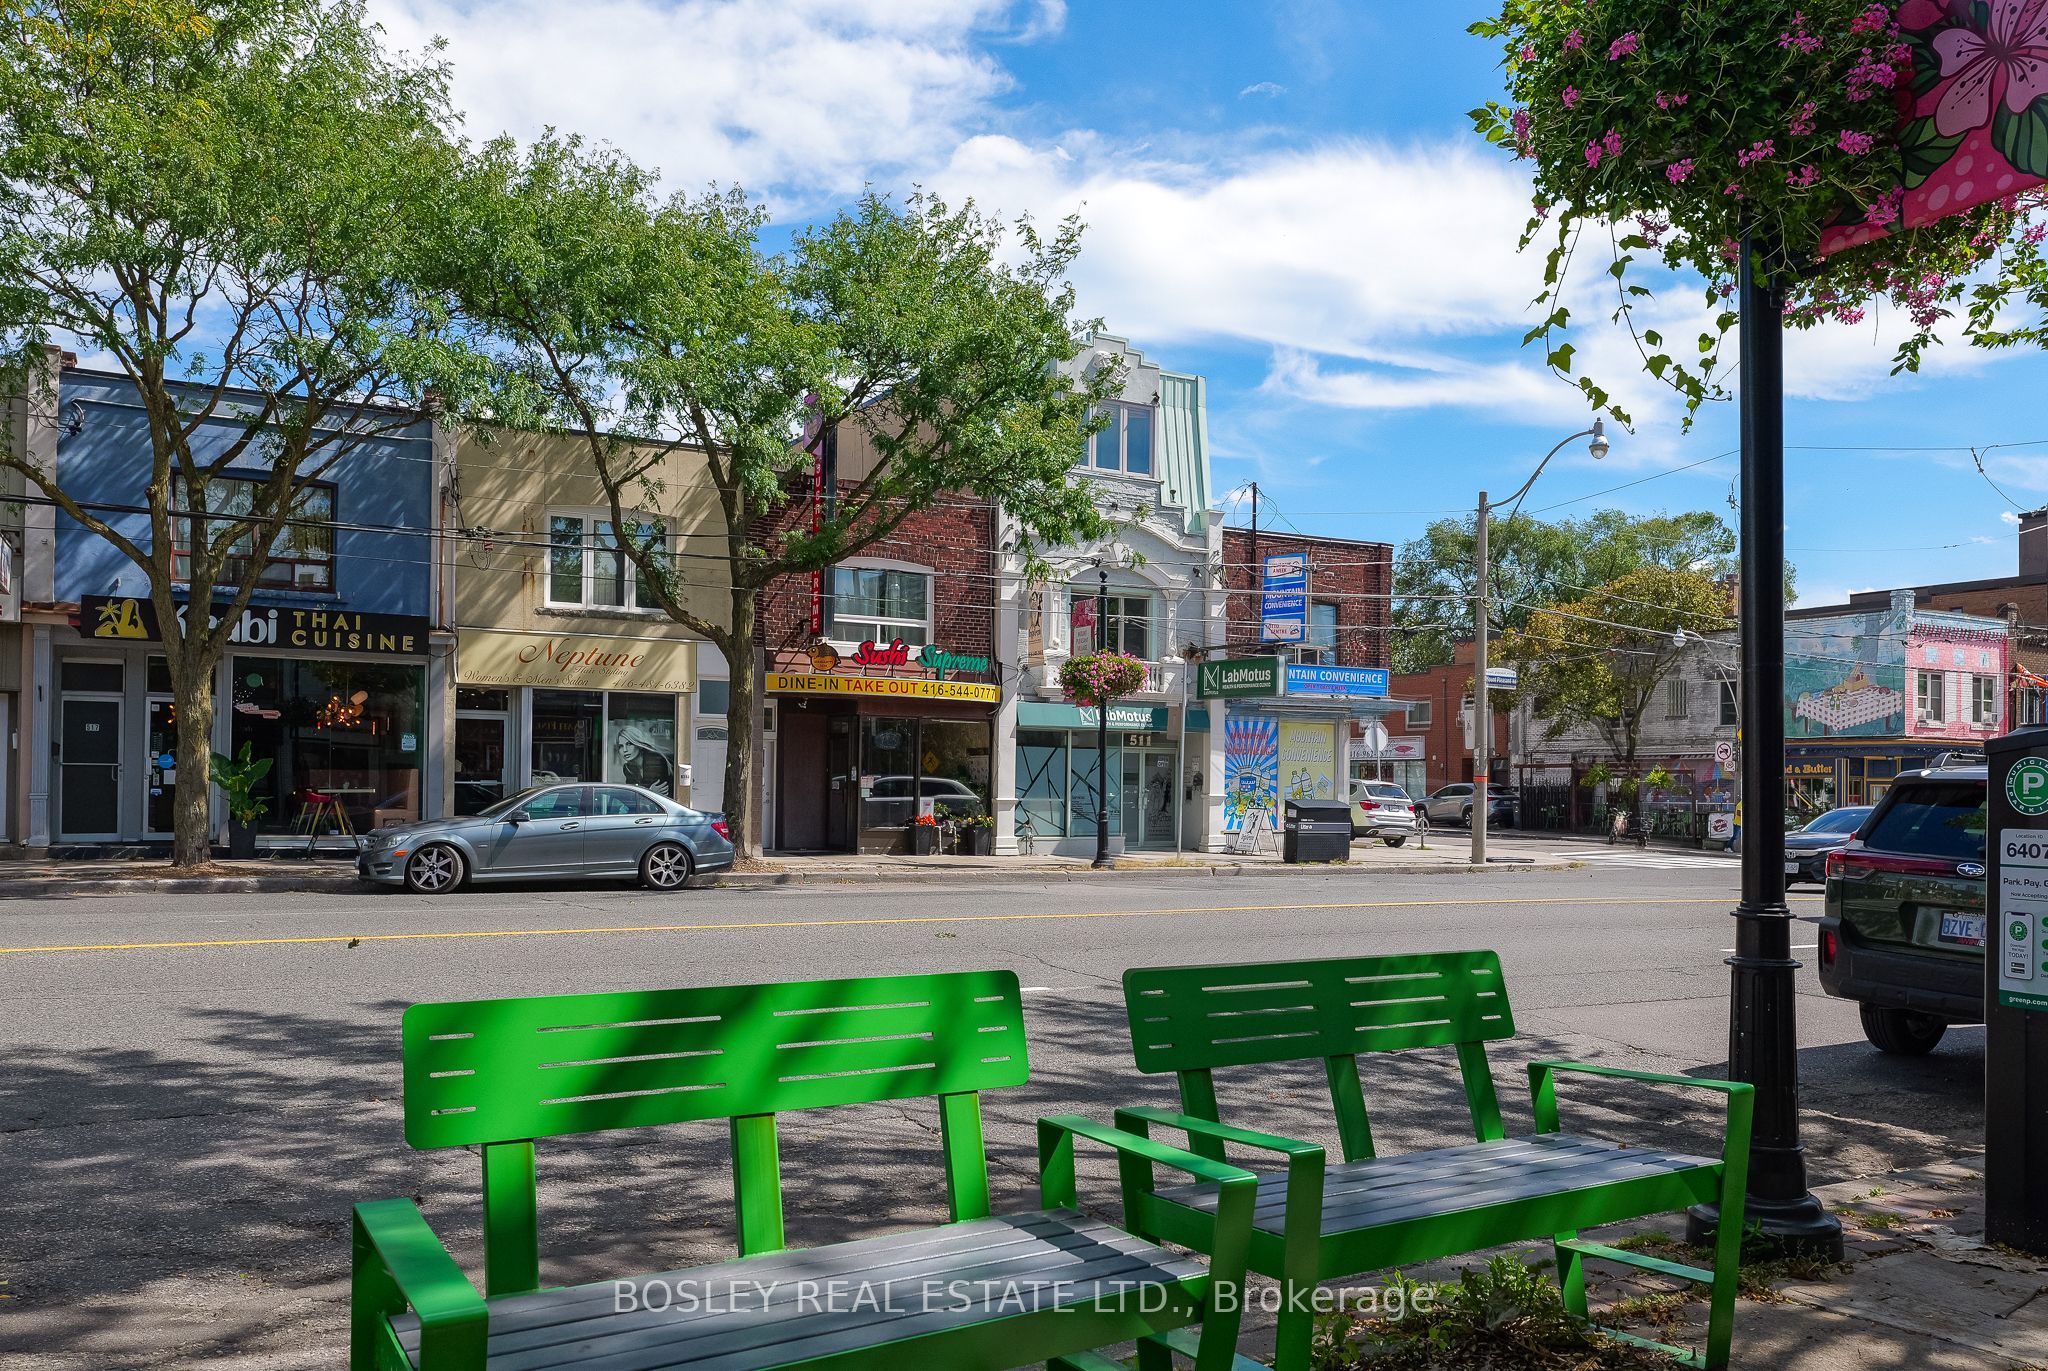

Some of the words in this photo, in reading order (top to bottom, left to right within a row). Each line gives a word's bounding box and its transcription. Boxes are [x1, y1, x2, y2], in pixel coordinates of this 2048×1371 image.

[1265, 600, 1303, 610] CONVENIENCE
[293, 611, 361, 631] THAI
[291, 630, 414, 652] CUISINE
[518, 638, 646, 672] Neptune
[853, 638, 910, 666] Sushi
[917, 644, 989, 681] Supreme
[464, 670, 509, 682] Women's
[513, 673, 521, 682] &
[525, 673, 559, 684] Men's
[562, 676, 588, 686] Salon
[575, 667, 597, 676] Hair
[1222, 669, 1271, 683] LabMotus
[1288, 669, 1316, 681] NTAIN
[1319, 671, 1382, 684] CONVENIENCE
[778, 677, 839, 691] DINE-IN
[844, 679, 884, 693] TAKE
[888, 681, 918, 695] OUT
[922, 685, 995, 700] 416-544-0777
[1129, 735, 1152, 747] 511
[1290, 729, 1327, 743] MOUNTAIN
[1281, 748, 1333, 763] CONVENIENCE
[1803, 764, 1833, 774] Butter
[2023, 772, 2045, 795] P
[2003, 877, 2022, 886] Park.
[2024, 879, 2042, 889] Pay.
[2008, 951, 2029, 960] TODAY!
[2009, 997, 2048, 1006] greenp.com
